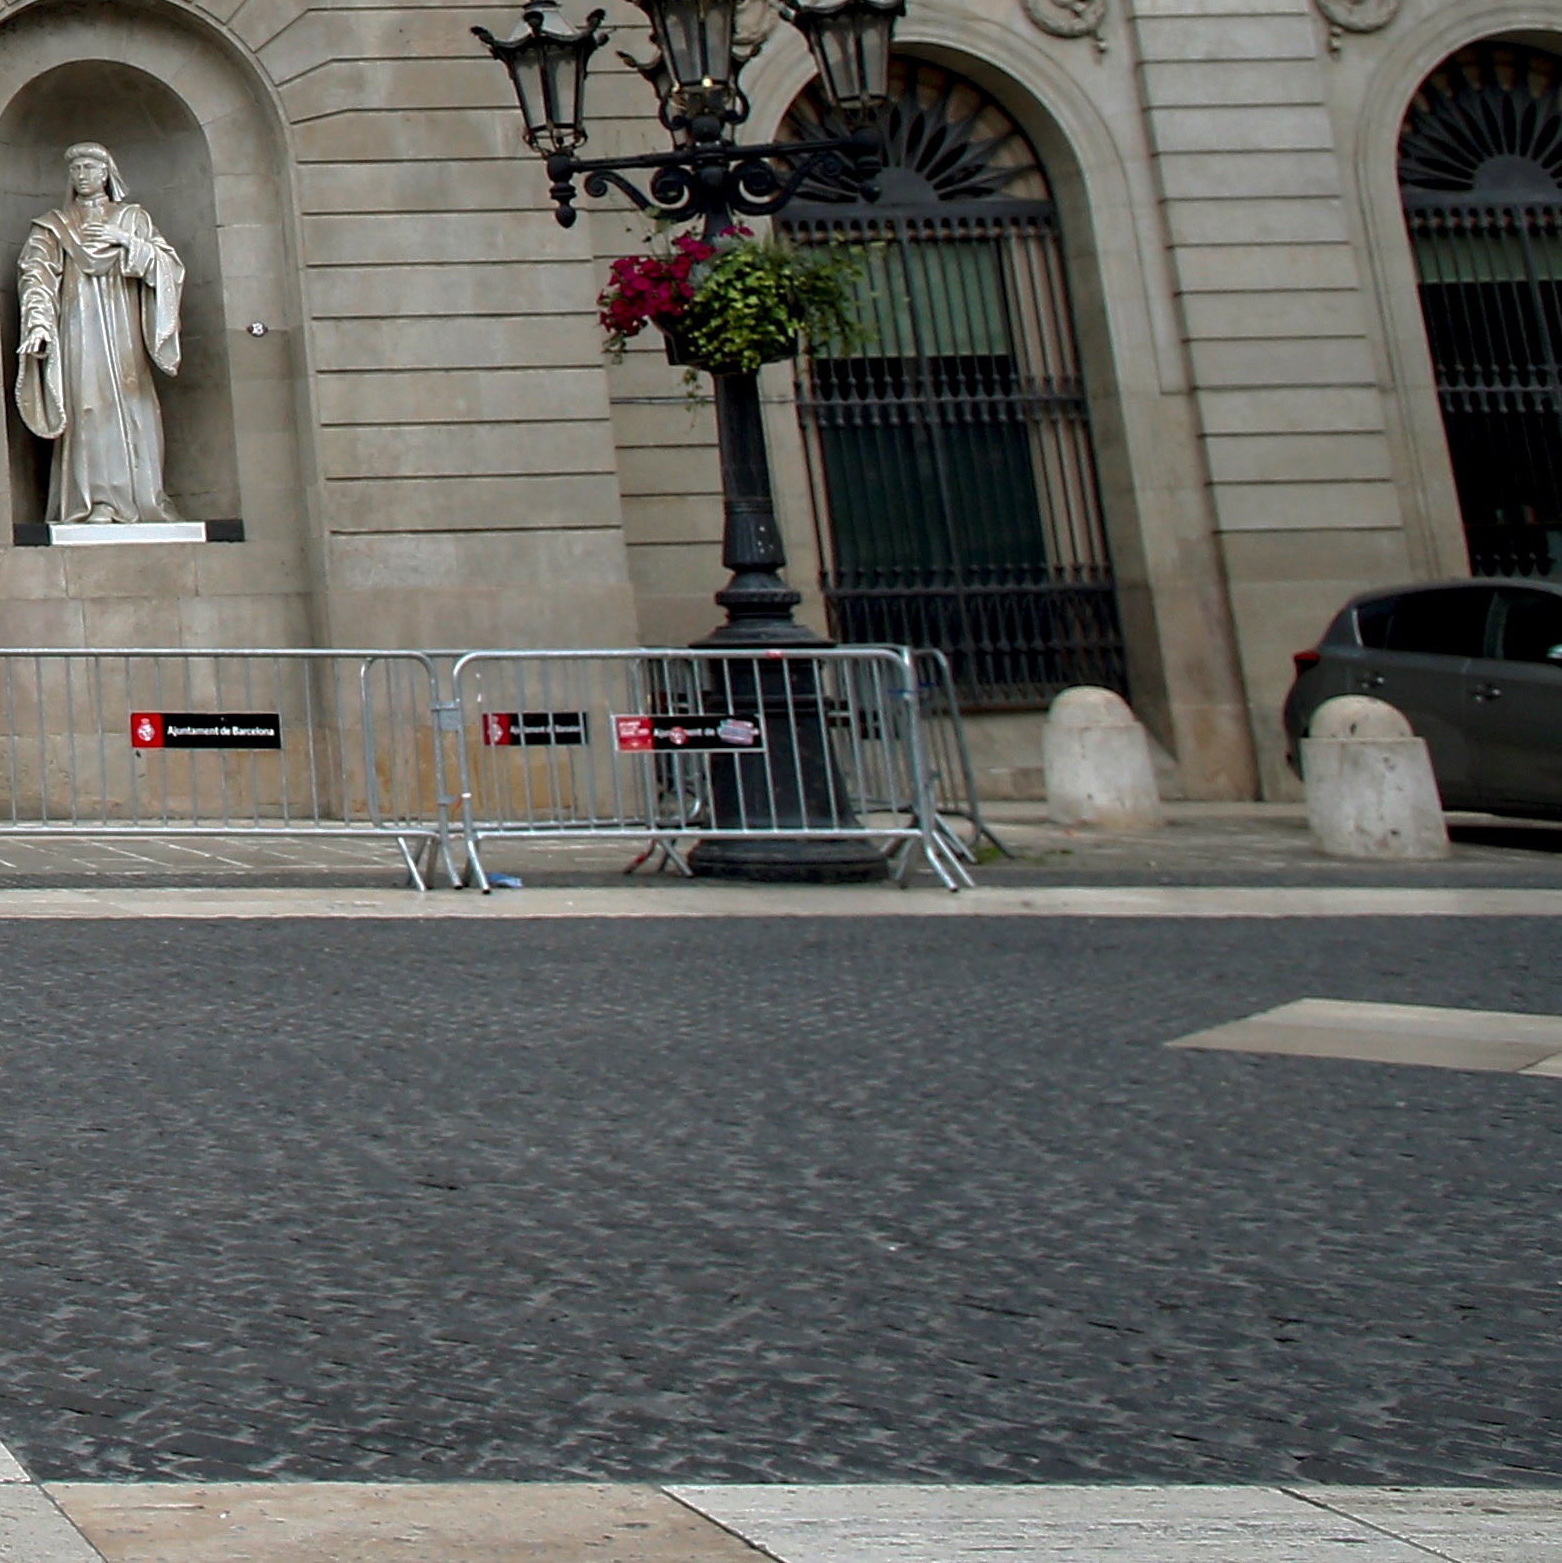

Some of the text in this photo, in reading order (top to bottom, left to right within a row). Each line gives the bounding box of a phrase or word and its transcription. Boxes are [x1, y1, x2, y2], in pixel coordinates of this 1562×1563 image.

[167, 726, 274, 737] Ajuntament de Barcelona
